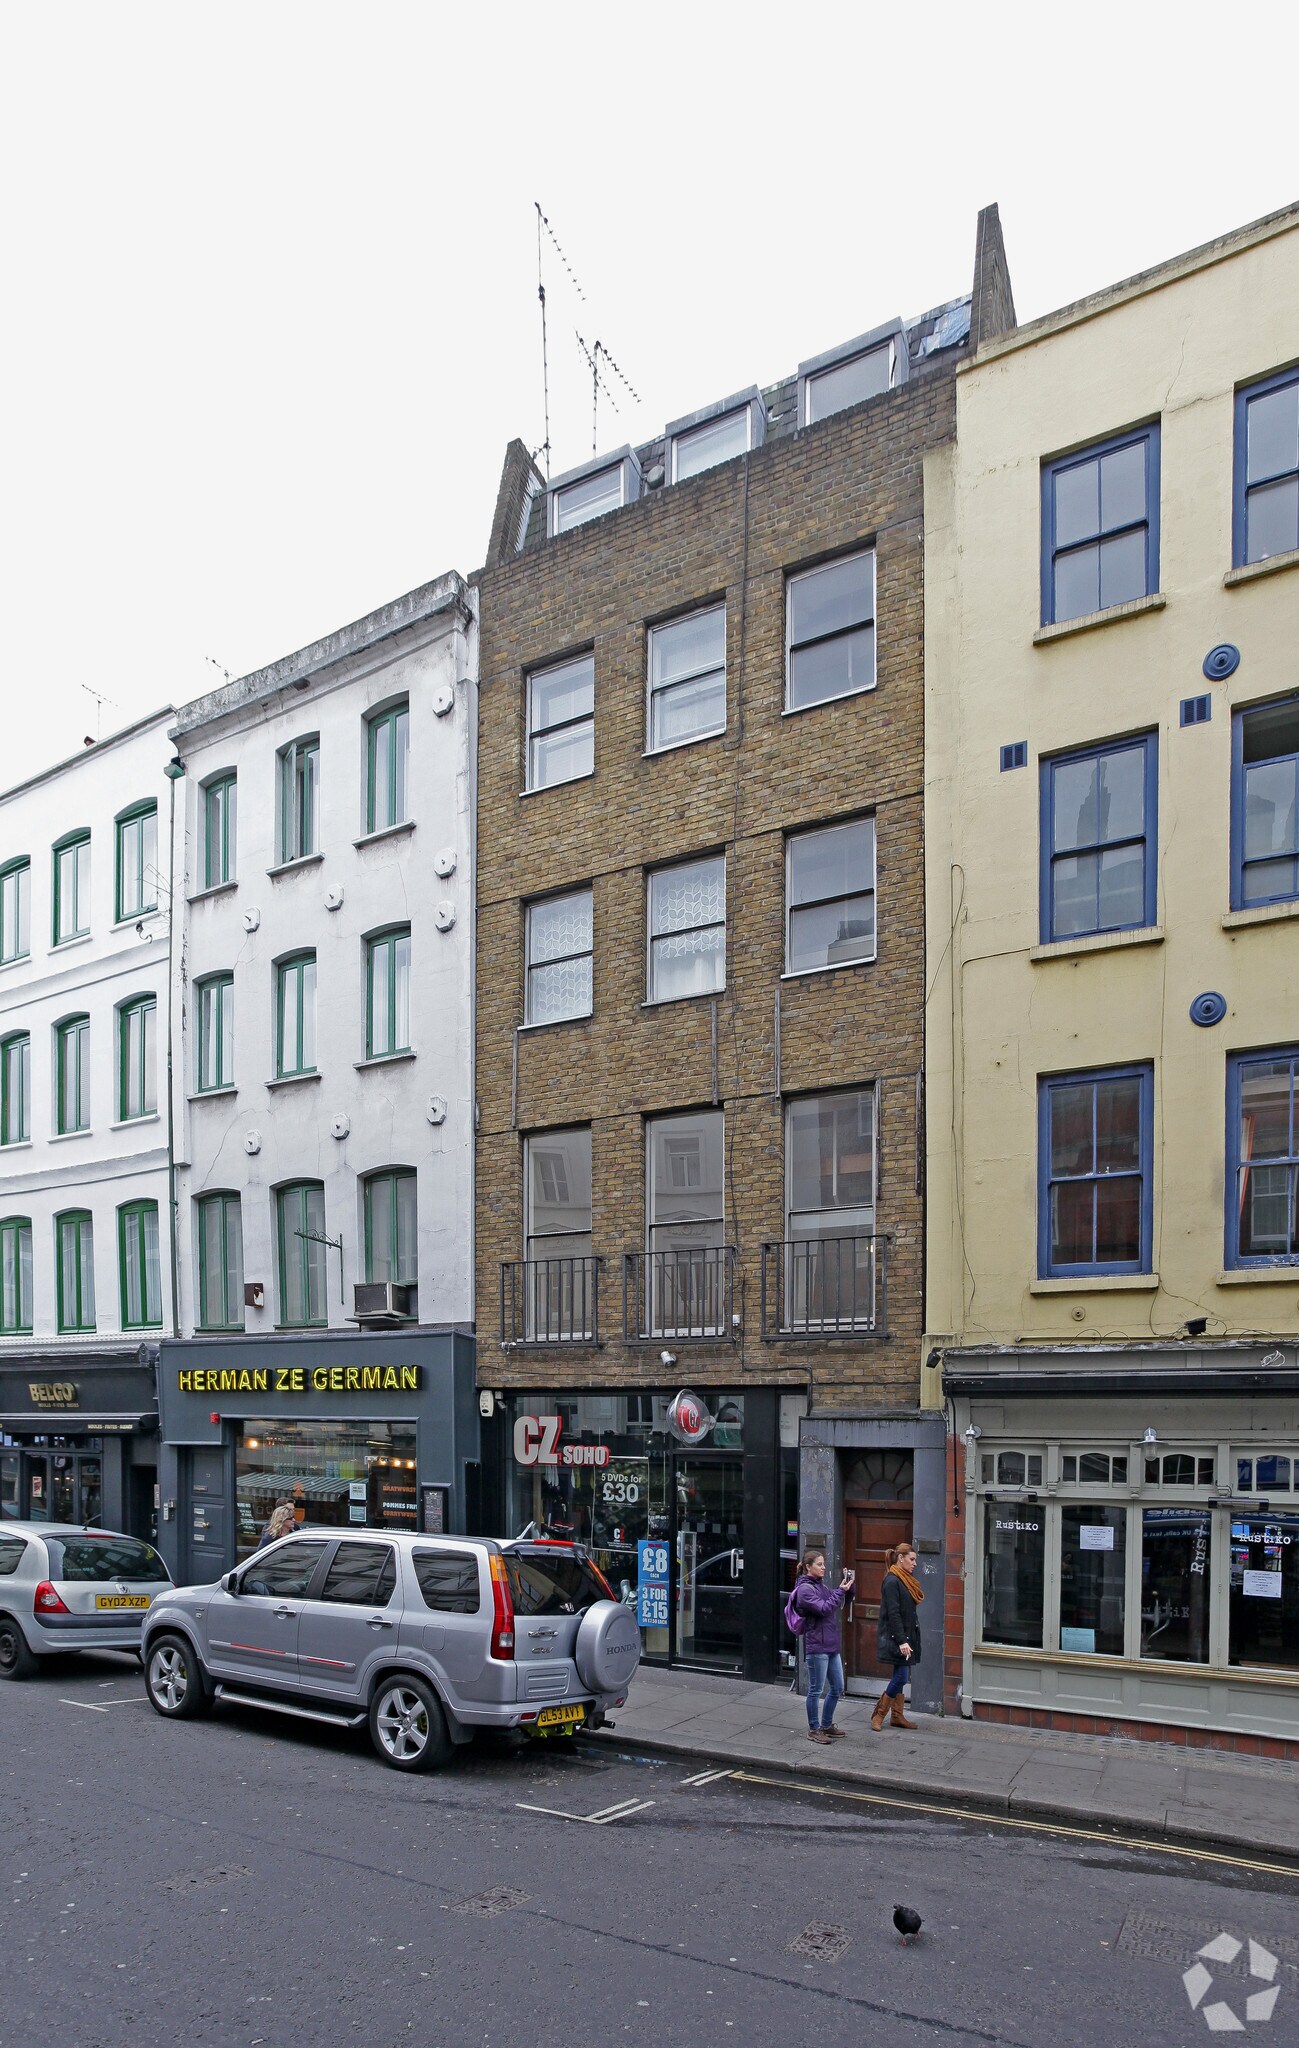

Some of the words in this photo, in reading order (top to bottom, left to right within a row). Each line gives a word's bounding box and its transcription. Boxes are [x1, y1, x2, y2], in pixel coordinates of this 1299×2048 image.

[178, 1369, 269, 1391] HERMAN
[274, 1367, 307, 1391] ZE
[311, 1364, 420, 1390] GERMAN
[28, 1382, 76, 1402] BELGO
[513, 1415, 562, 1466] CZ
[562, 1445, 610, 1466] SOHO
[601, 1473, 606, 1481] 5
[607, 1474, 629, 1483] DVDs
[630, 1475, 642, 1483] for
[603, 1482, 639, 1503] £30
[613, 1527, 625, 1541] CZ
[642, 1547, 668, 1573] £8
[100, 1597, 127, 1607] GY02
[128, 1597, 147, 1607] XZP
[642, 1587, 648, 1599] 3
[650, 1588, 667, 1601] FOR
[642, 1600, 668, 1619] £15
[606, 1643, 637, 1655] HONDA
[541, 1709, 563, 1723] GL53
[800, 1932, 846, 1948] METER
